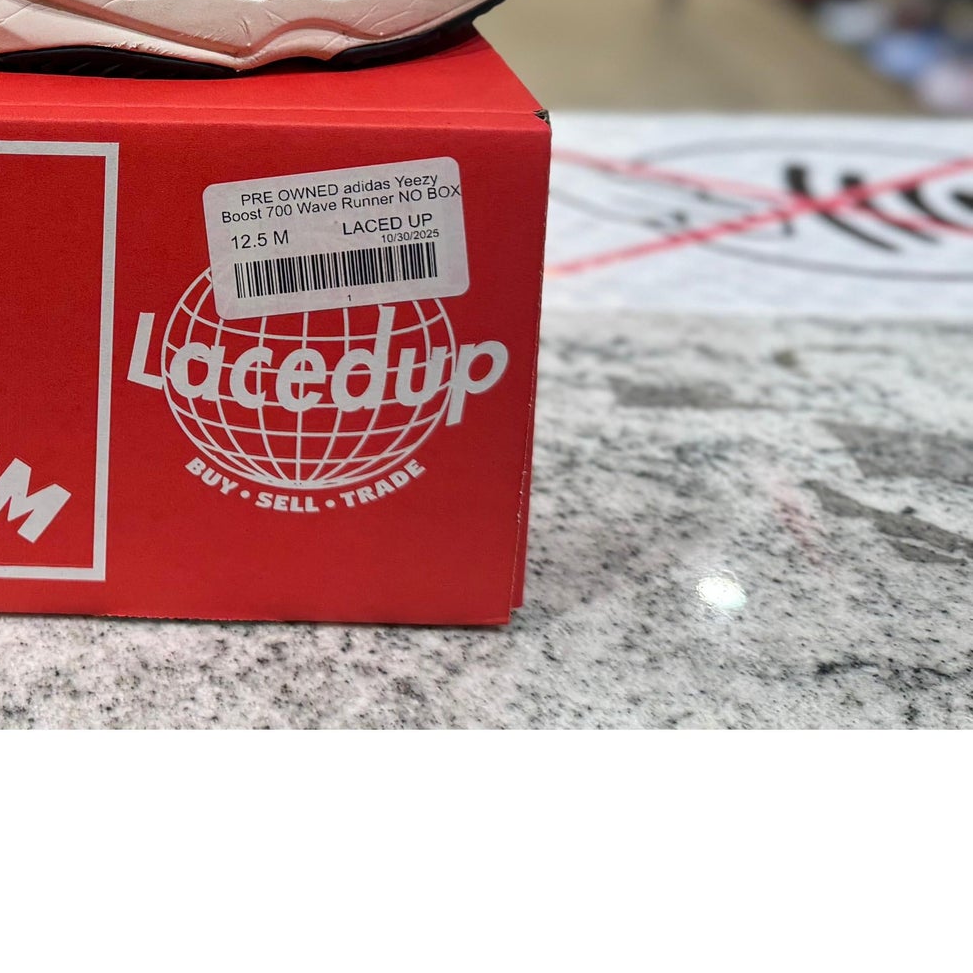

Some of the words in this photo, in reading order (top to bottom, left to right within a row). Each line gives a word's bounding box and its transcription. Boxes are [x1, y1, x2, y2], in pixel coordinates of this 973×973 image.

[241, 191, 273, 206] PRE
[278, 183, 338, 202] OWNED
[343, 177, 391, 194] adidas
[394, 174, 438, 189] Yeezy
[222, 207, 263, 224] Boost
[266, 204, 293, 218] 700
[296, 199, 337, 214] Wave
[342, 194, 394, 209] Runner
[399, 188, 422, 203] NO
[428, 184, 462, 200] BOX
[342, 216, 403, 235] LACED
[408, 213, 433, 228] UP
[381, 229, 440, 243] 10/30/2025
[231, 232, 268, 250] 12.5
[273, 230, 289, 245] M
[347, 294, 352, 302] 1
[127, 305, 509, 426] Lacedup
[185, 456, 239, 495] BUY
[255, 491, 320, 513] SELL
[339, 459, 426, 508] TRADE
